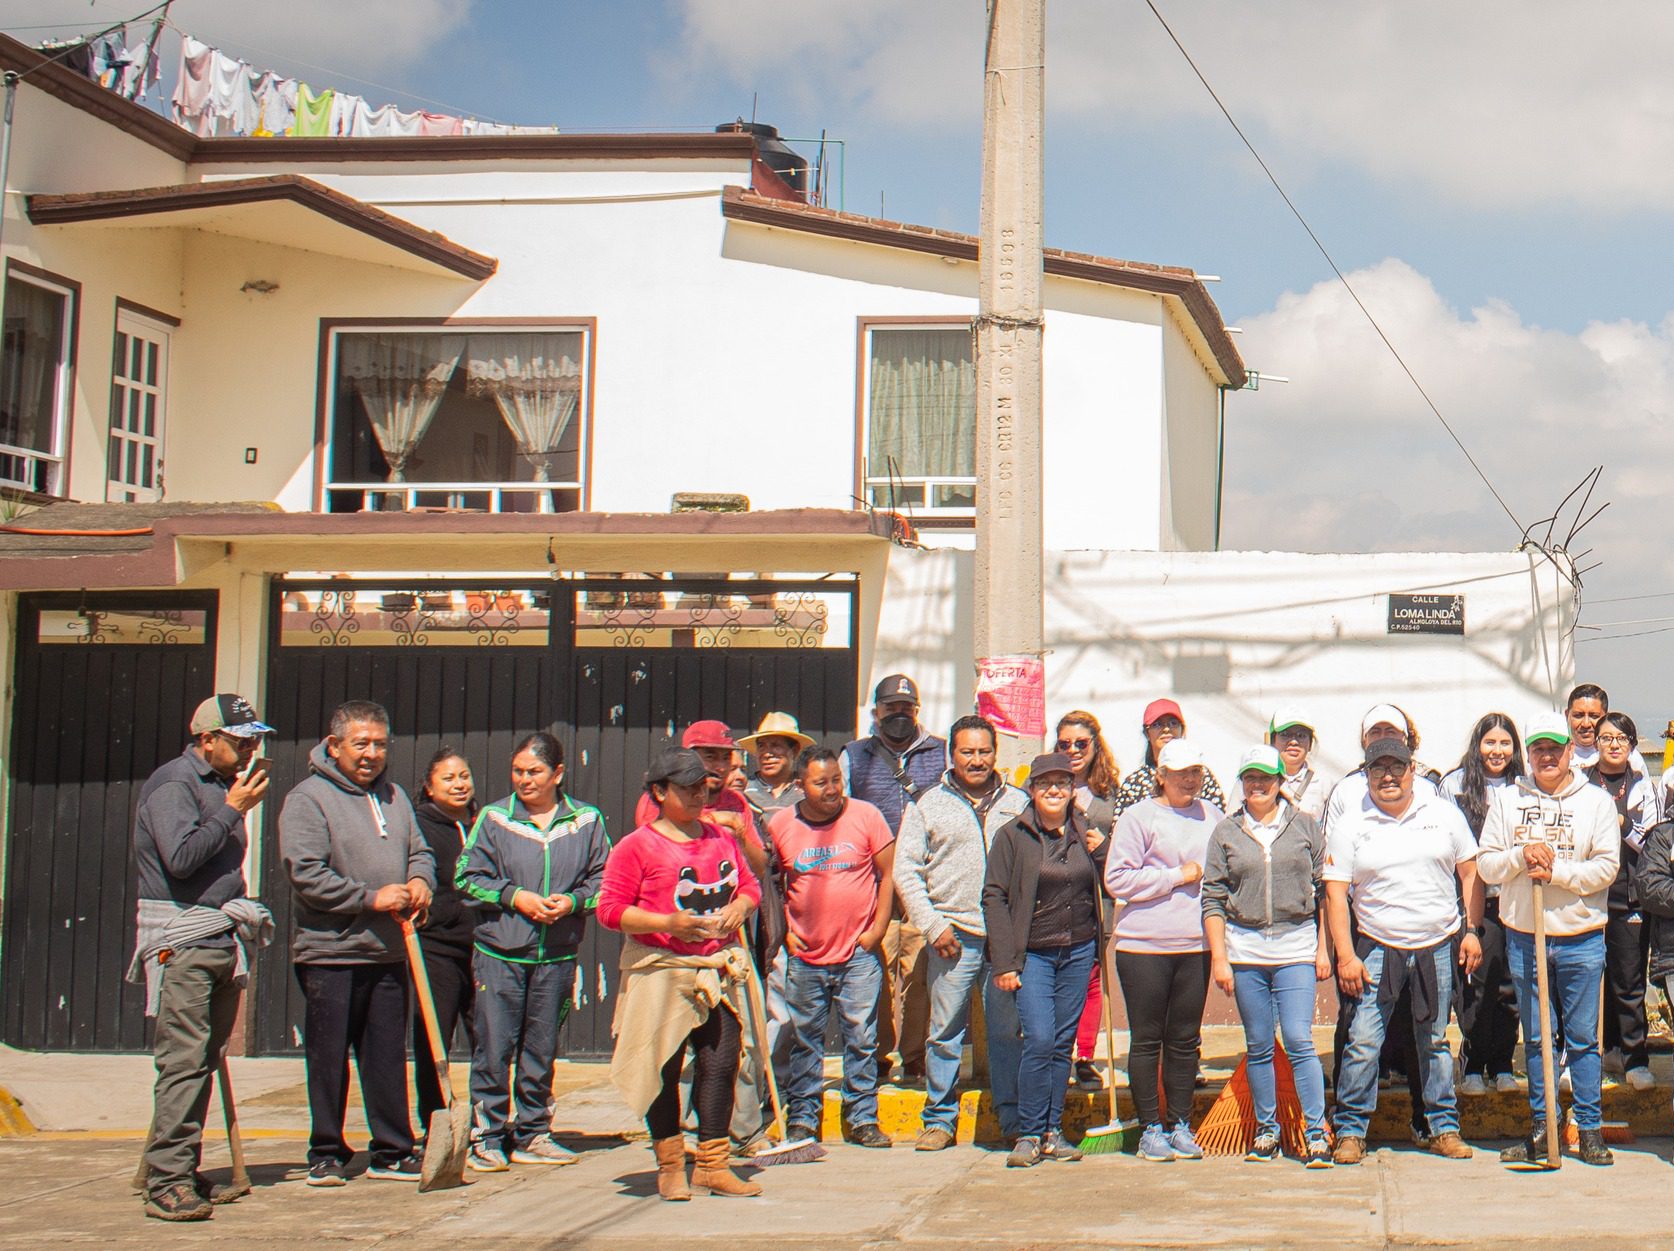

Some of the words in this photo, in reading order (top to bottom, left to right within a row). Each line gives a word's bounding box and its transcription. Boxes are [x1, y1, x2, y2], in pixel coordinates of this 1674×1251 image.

[1411, 596, 1440, 604] CALLE
[1394, 608, 1425, 618] LOMA
[1426, 608, 1456, 619] LINDA
[986, 667, 1027, 679] OFERTA
[1517, 805, 1574, 828] TRUE
